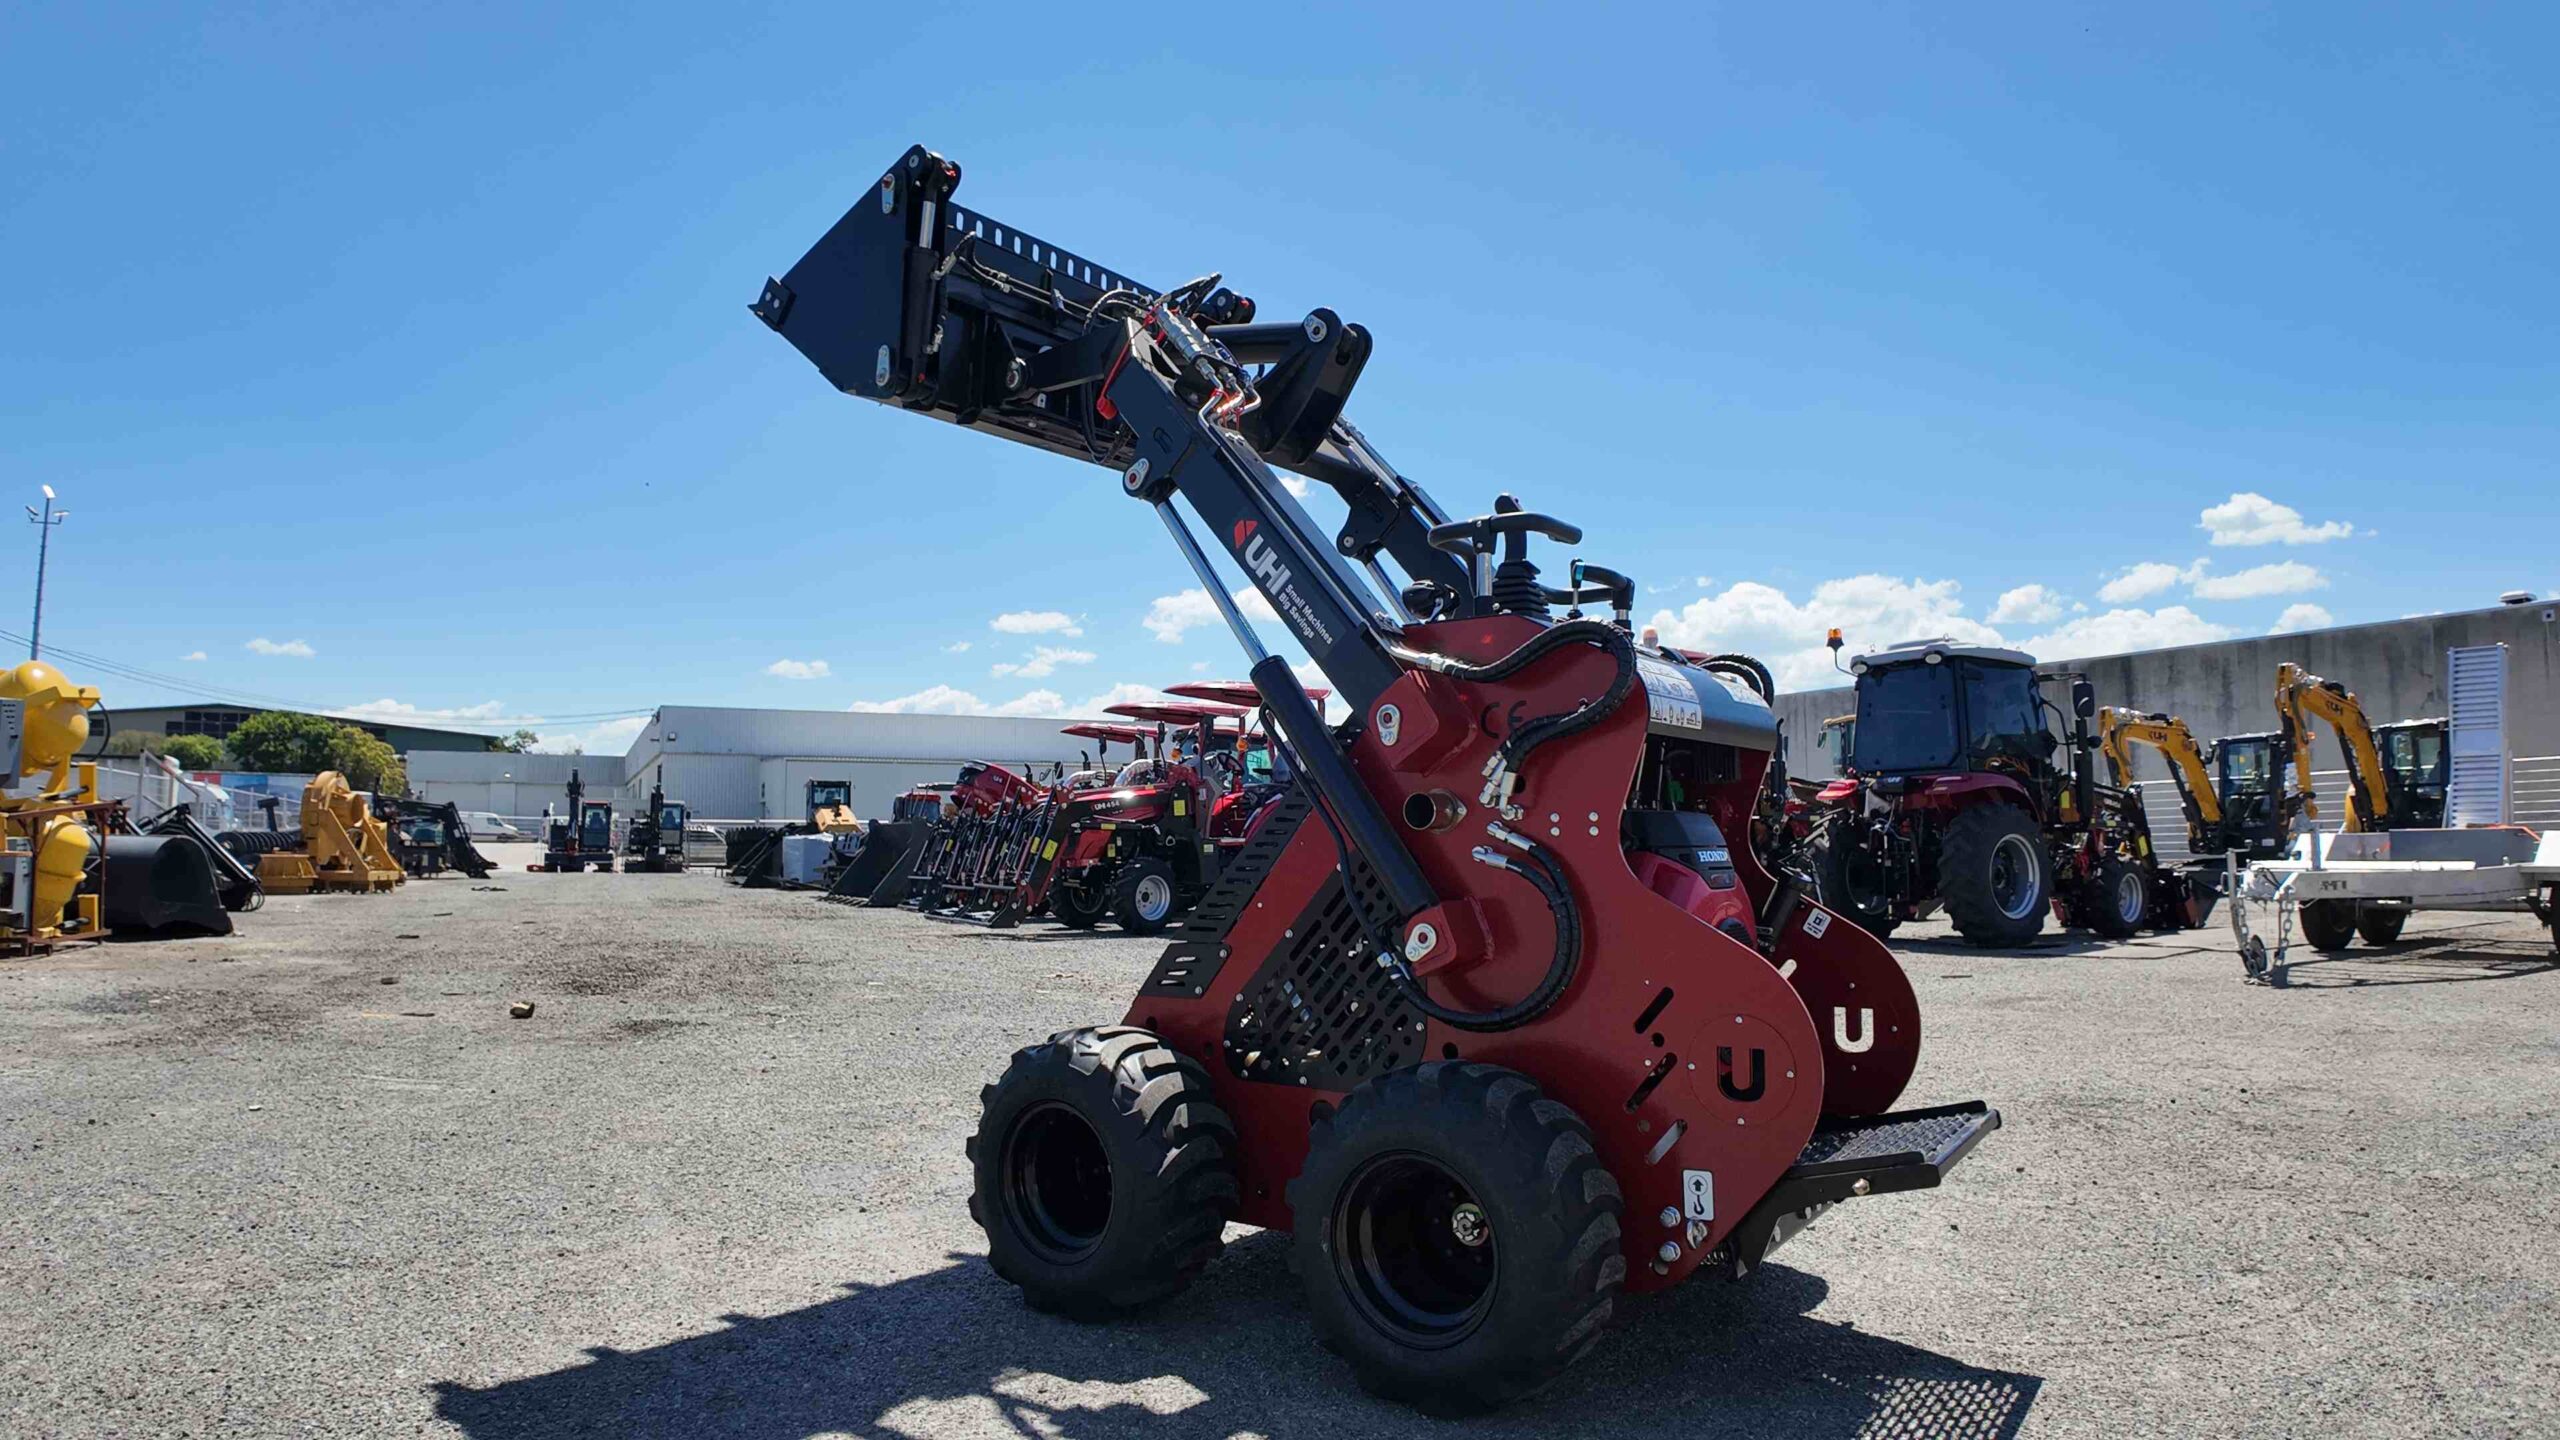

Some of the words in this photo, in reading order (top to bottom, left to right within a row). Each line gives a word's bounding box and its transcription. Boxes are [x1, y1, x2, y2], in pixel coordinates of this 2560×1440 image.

[1245, 533, 1292, 596] UHI
[1278, 592, 1291, 611] Big
[1289, 606, 1316, 639] Savings
[1285, 584, 1306, 609] Small
[1302, 605, 1334, 645] Machines
[1697, 850, 1732, 862] HOND
[1834, 1006, 1874, 1053] U
[1717, 1046, 1765, 1101] U
